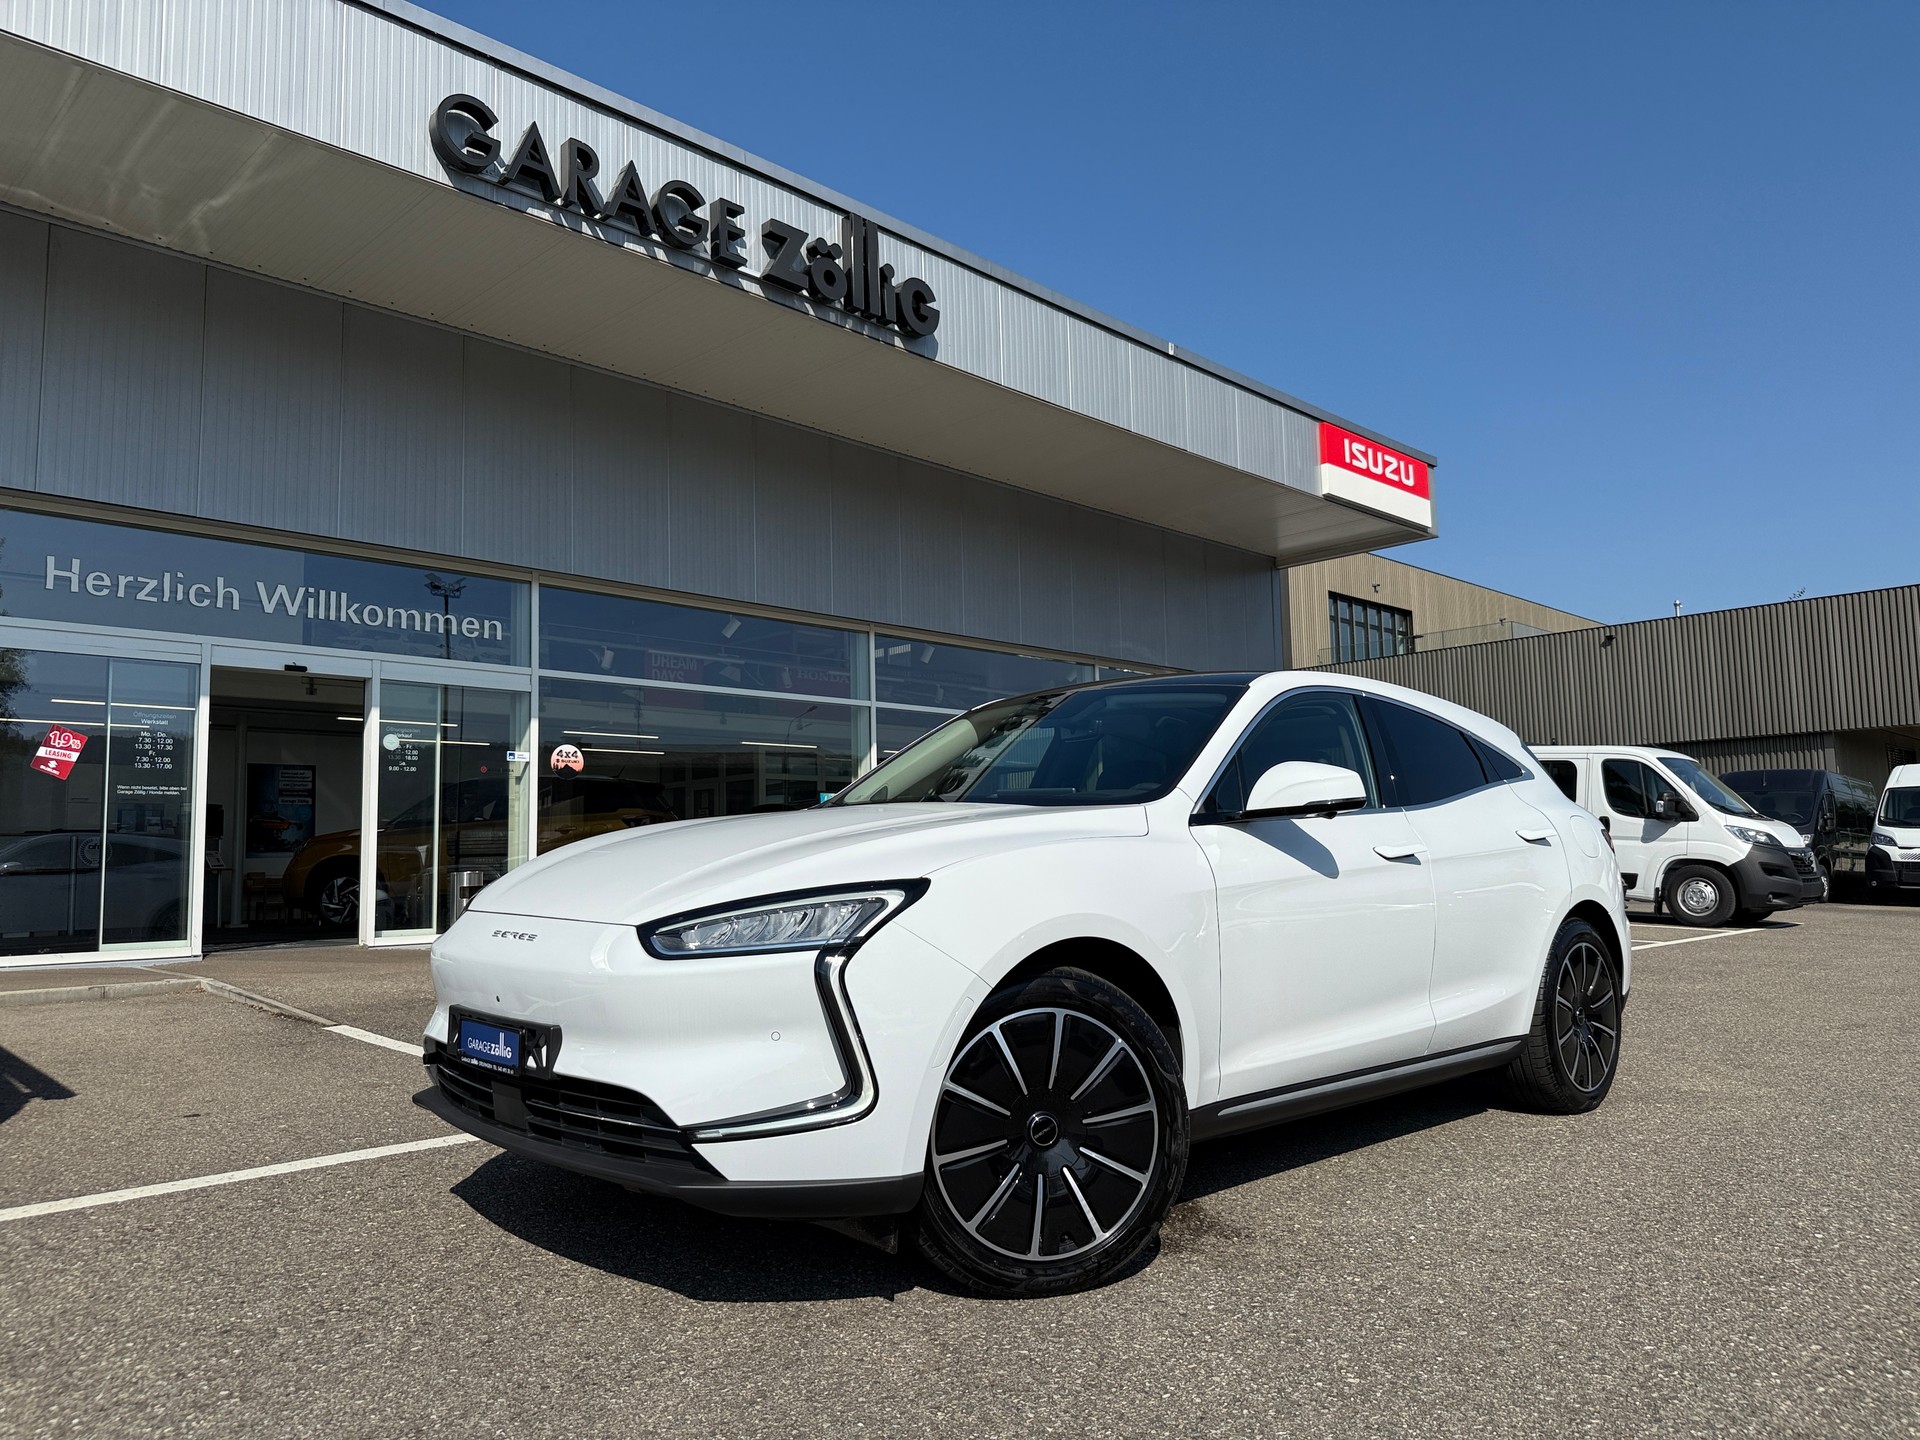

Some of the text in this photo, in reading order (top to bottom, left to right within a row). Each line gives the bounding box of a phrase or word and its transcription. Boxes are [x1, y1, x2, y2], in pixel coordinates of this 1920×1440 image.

[429, 93, 748, 269] GARAGE
[1344, 438, 1414, 486] ISUZU
[46, 555, 503, 641] Herzlich Willkommen
[651, 653, 697, 671] DREAM
[651, 668, 685, 683] DAYS
[797, 670, 850, 685] HONDA
[45, 750, 72, 759] LEASING
[556, 749, 578, 759] 4x4
[492, 930, 538, 942] SERES
[468, 1037, 491, 1054] GARAGE
